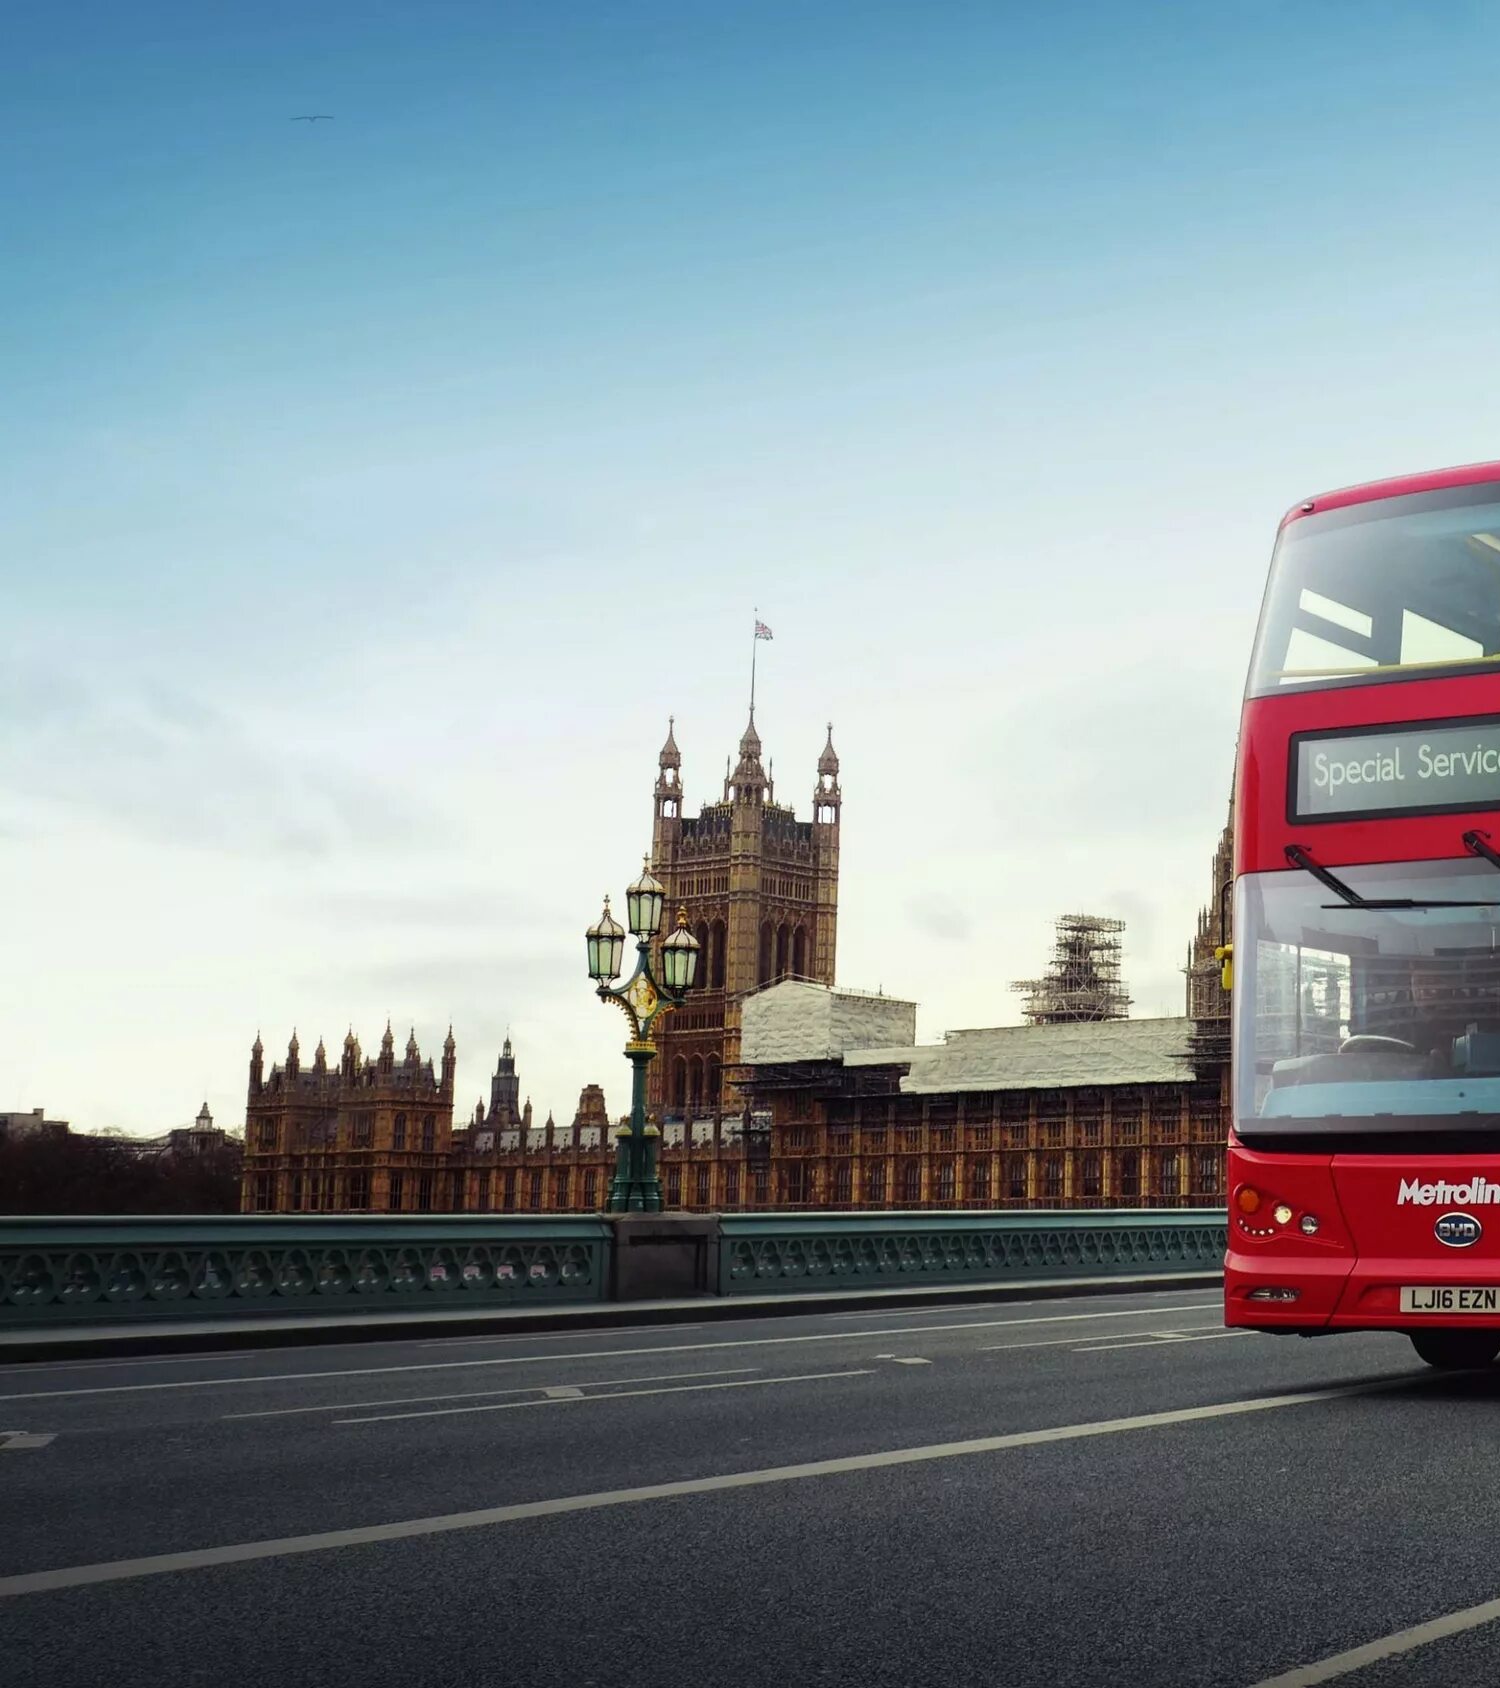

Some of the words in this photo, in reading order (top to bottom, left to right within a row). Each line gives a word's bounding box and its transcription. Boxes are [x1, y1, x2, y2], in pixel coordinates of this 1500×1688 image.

[1313, 747, 1405, 796] Special
[1439, 1223, 1475, 1237] BYD
[1411, 1289, 1453, 1309] LJ16
[1458, 1289, 1496, 1309] EZN
